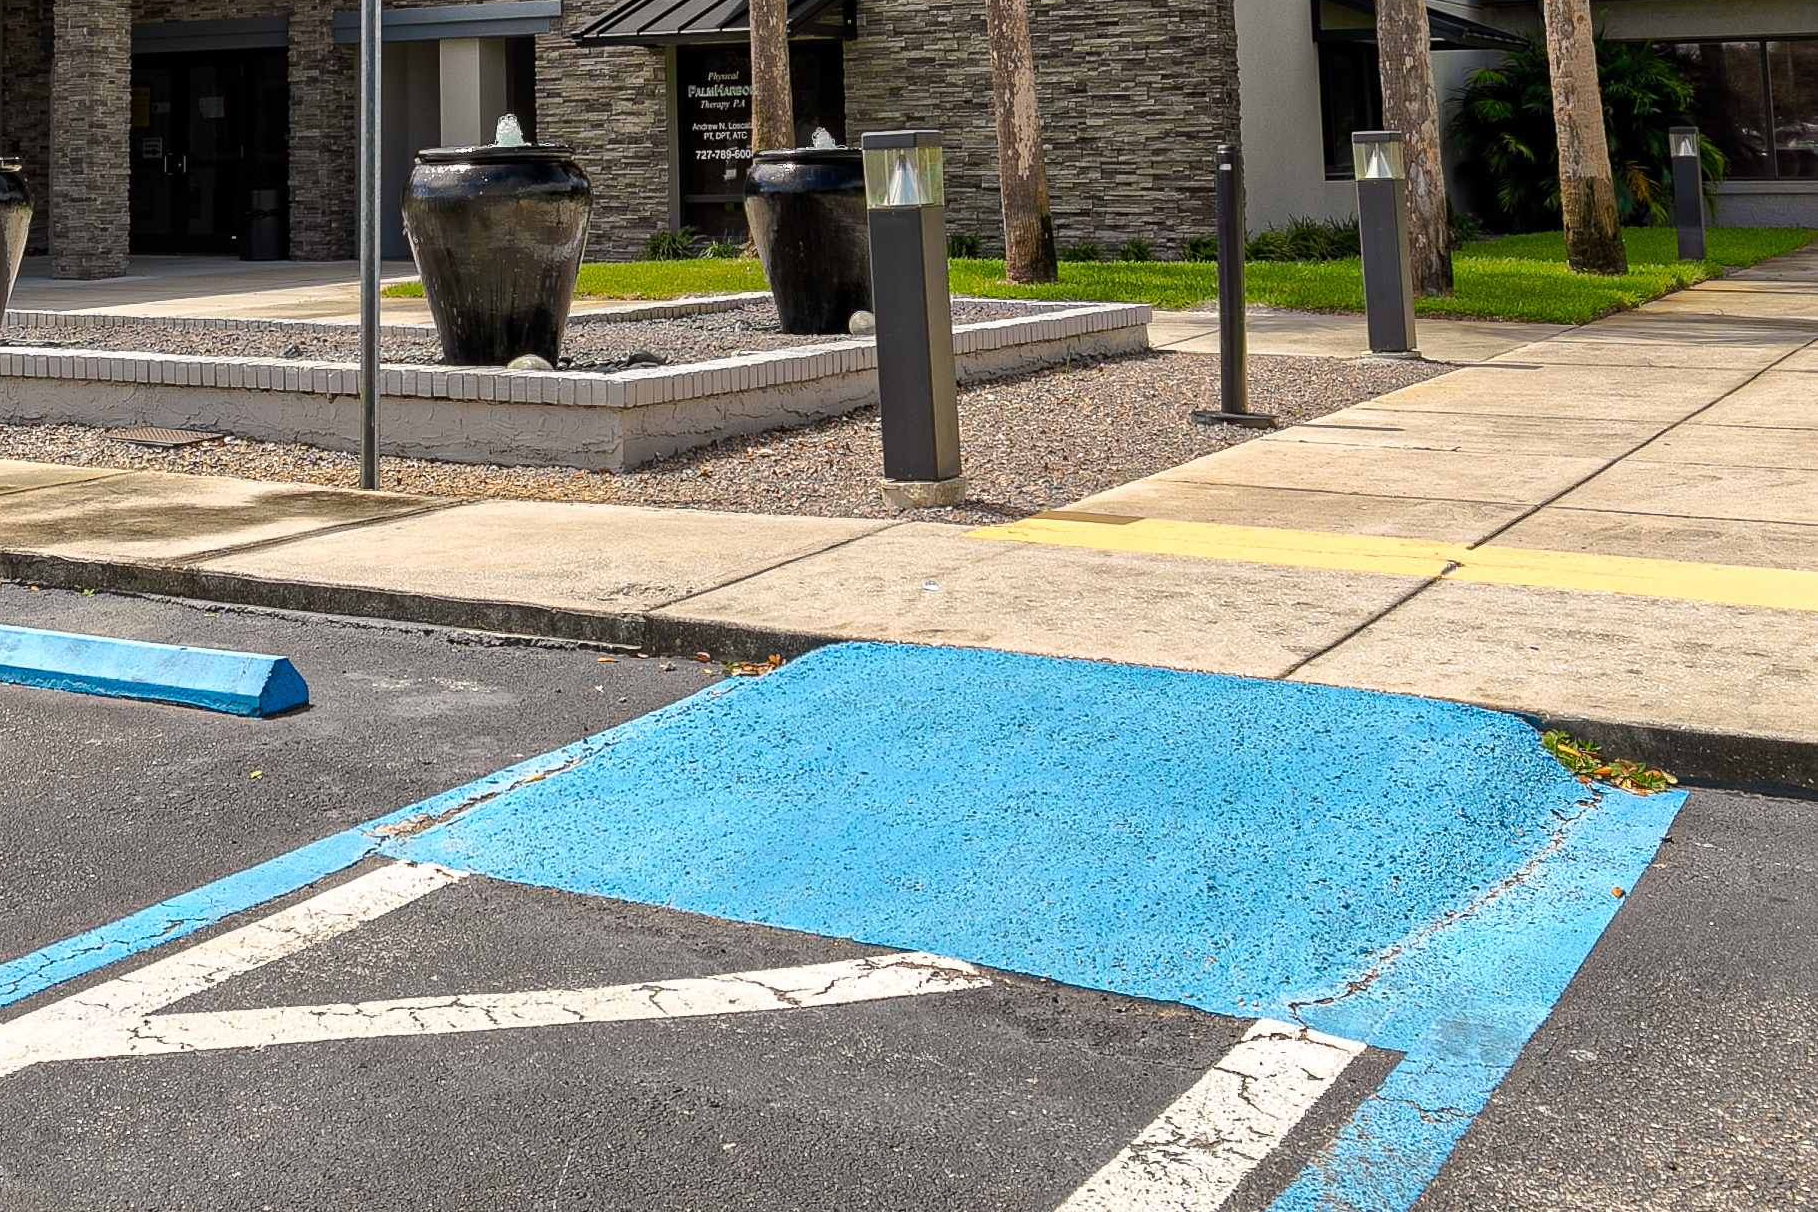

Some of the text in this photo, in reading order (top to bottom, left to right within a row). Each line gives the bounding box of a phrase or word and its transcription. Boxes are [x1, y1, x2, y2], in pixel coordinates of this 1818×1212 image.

[708, 71, 739, 82] Physical
[700, 99, 731, 111] Therapy
[718, 122, 727, 130] N.
[703, 131, 748, 141] PT, DPT, ATC
